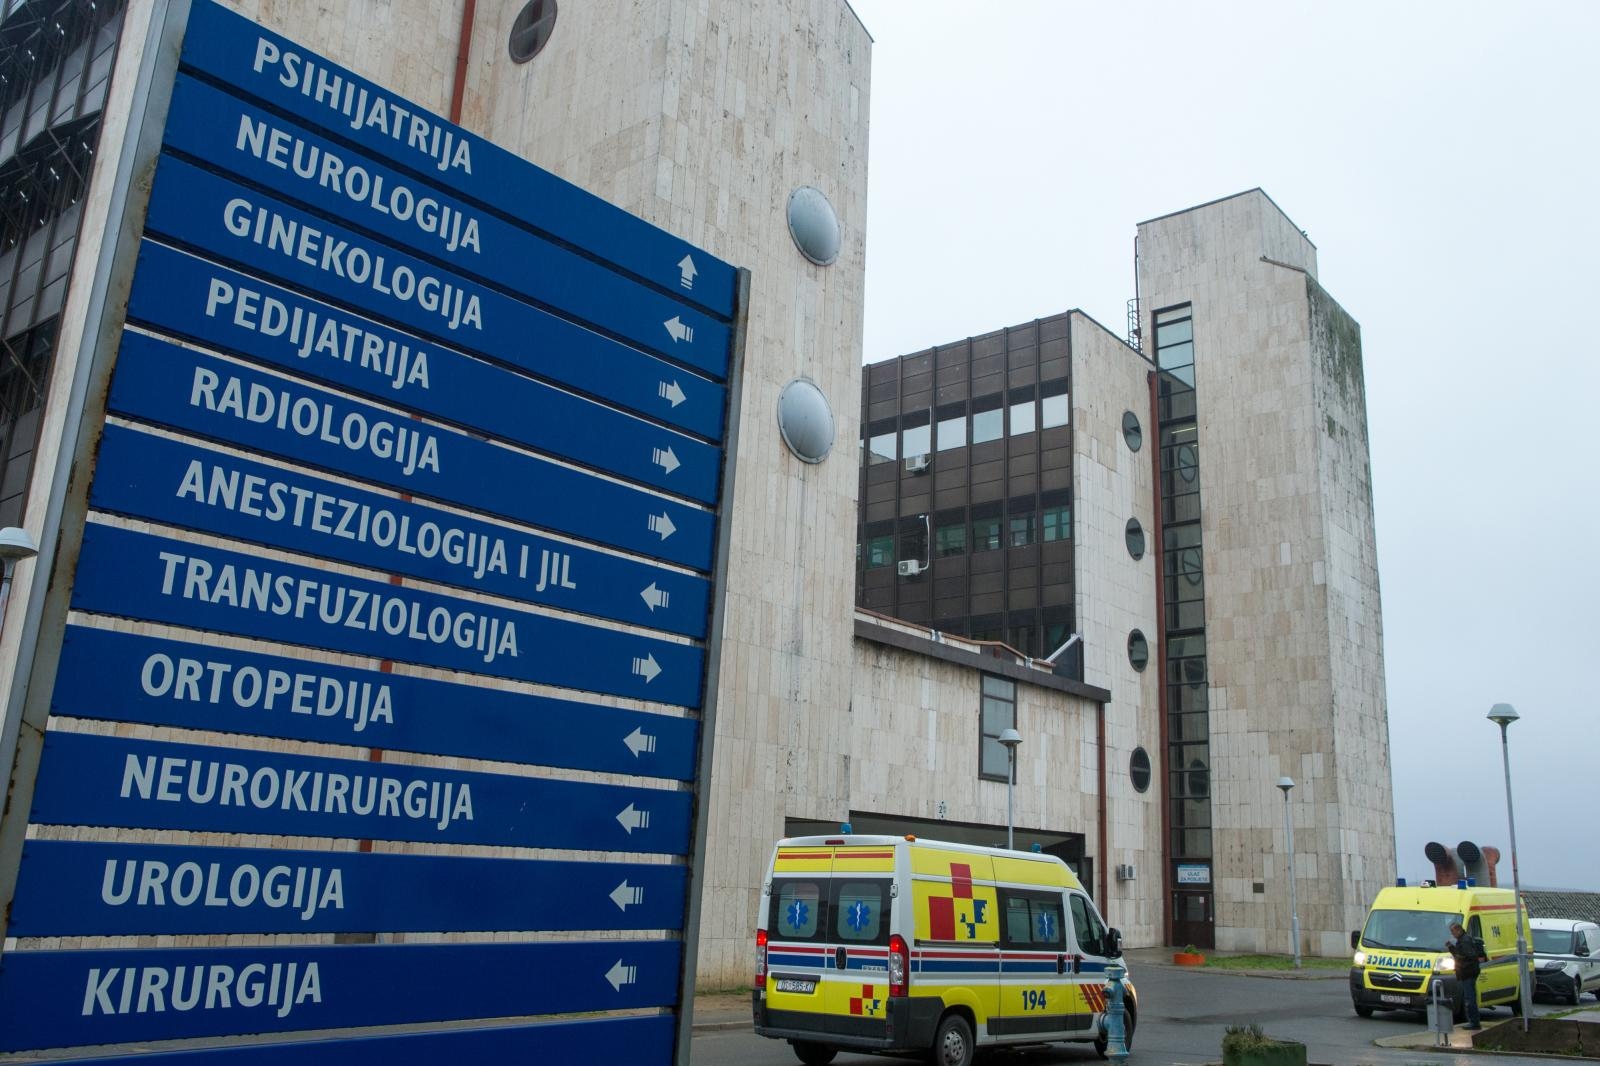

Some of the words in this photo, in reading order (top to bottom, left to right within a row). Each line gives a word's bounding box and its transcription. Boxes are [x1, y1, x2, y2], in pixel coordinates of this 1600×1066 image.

[253, 37, 473, 175] PSIHIJATRIJA
[236, 114, 481, 254] NEUROLOGIJA
[223, 198, 483, 330] GINEKOLOGIJA
[205, 277, 430, 390] PEDIJATRIJA
[190, 366, 441, 476] RADIOLOGIJA
[176, 459, 509, 580] ANESTEZIOLOGIJA
[519, 544, 529, 579] I
[535, 549, 577, 592] JIL
[159, 551, 519, 663] TRANSFUZIOLOGIJA
[141, 653, 395, 732] ORTOPEDIJA
[120, 753, 475, 831] NEUROKIRURGIJA
[101, 859, 345, 921] UROLOGIJA
[82, 962, 323, 1018] KIRURGIJA
[1022, 989, 1047, 1010] 194
